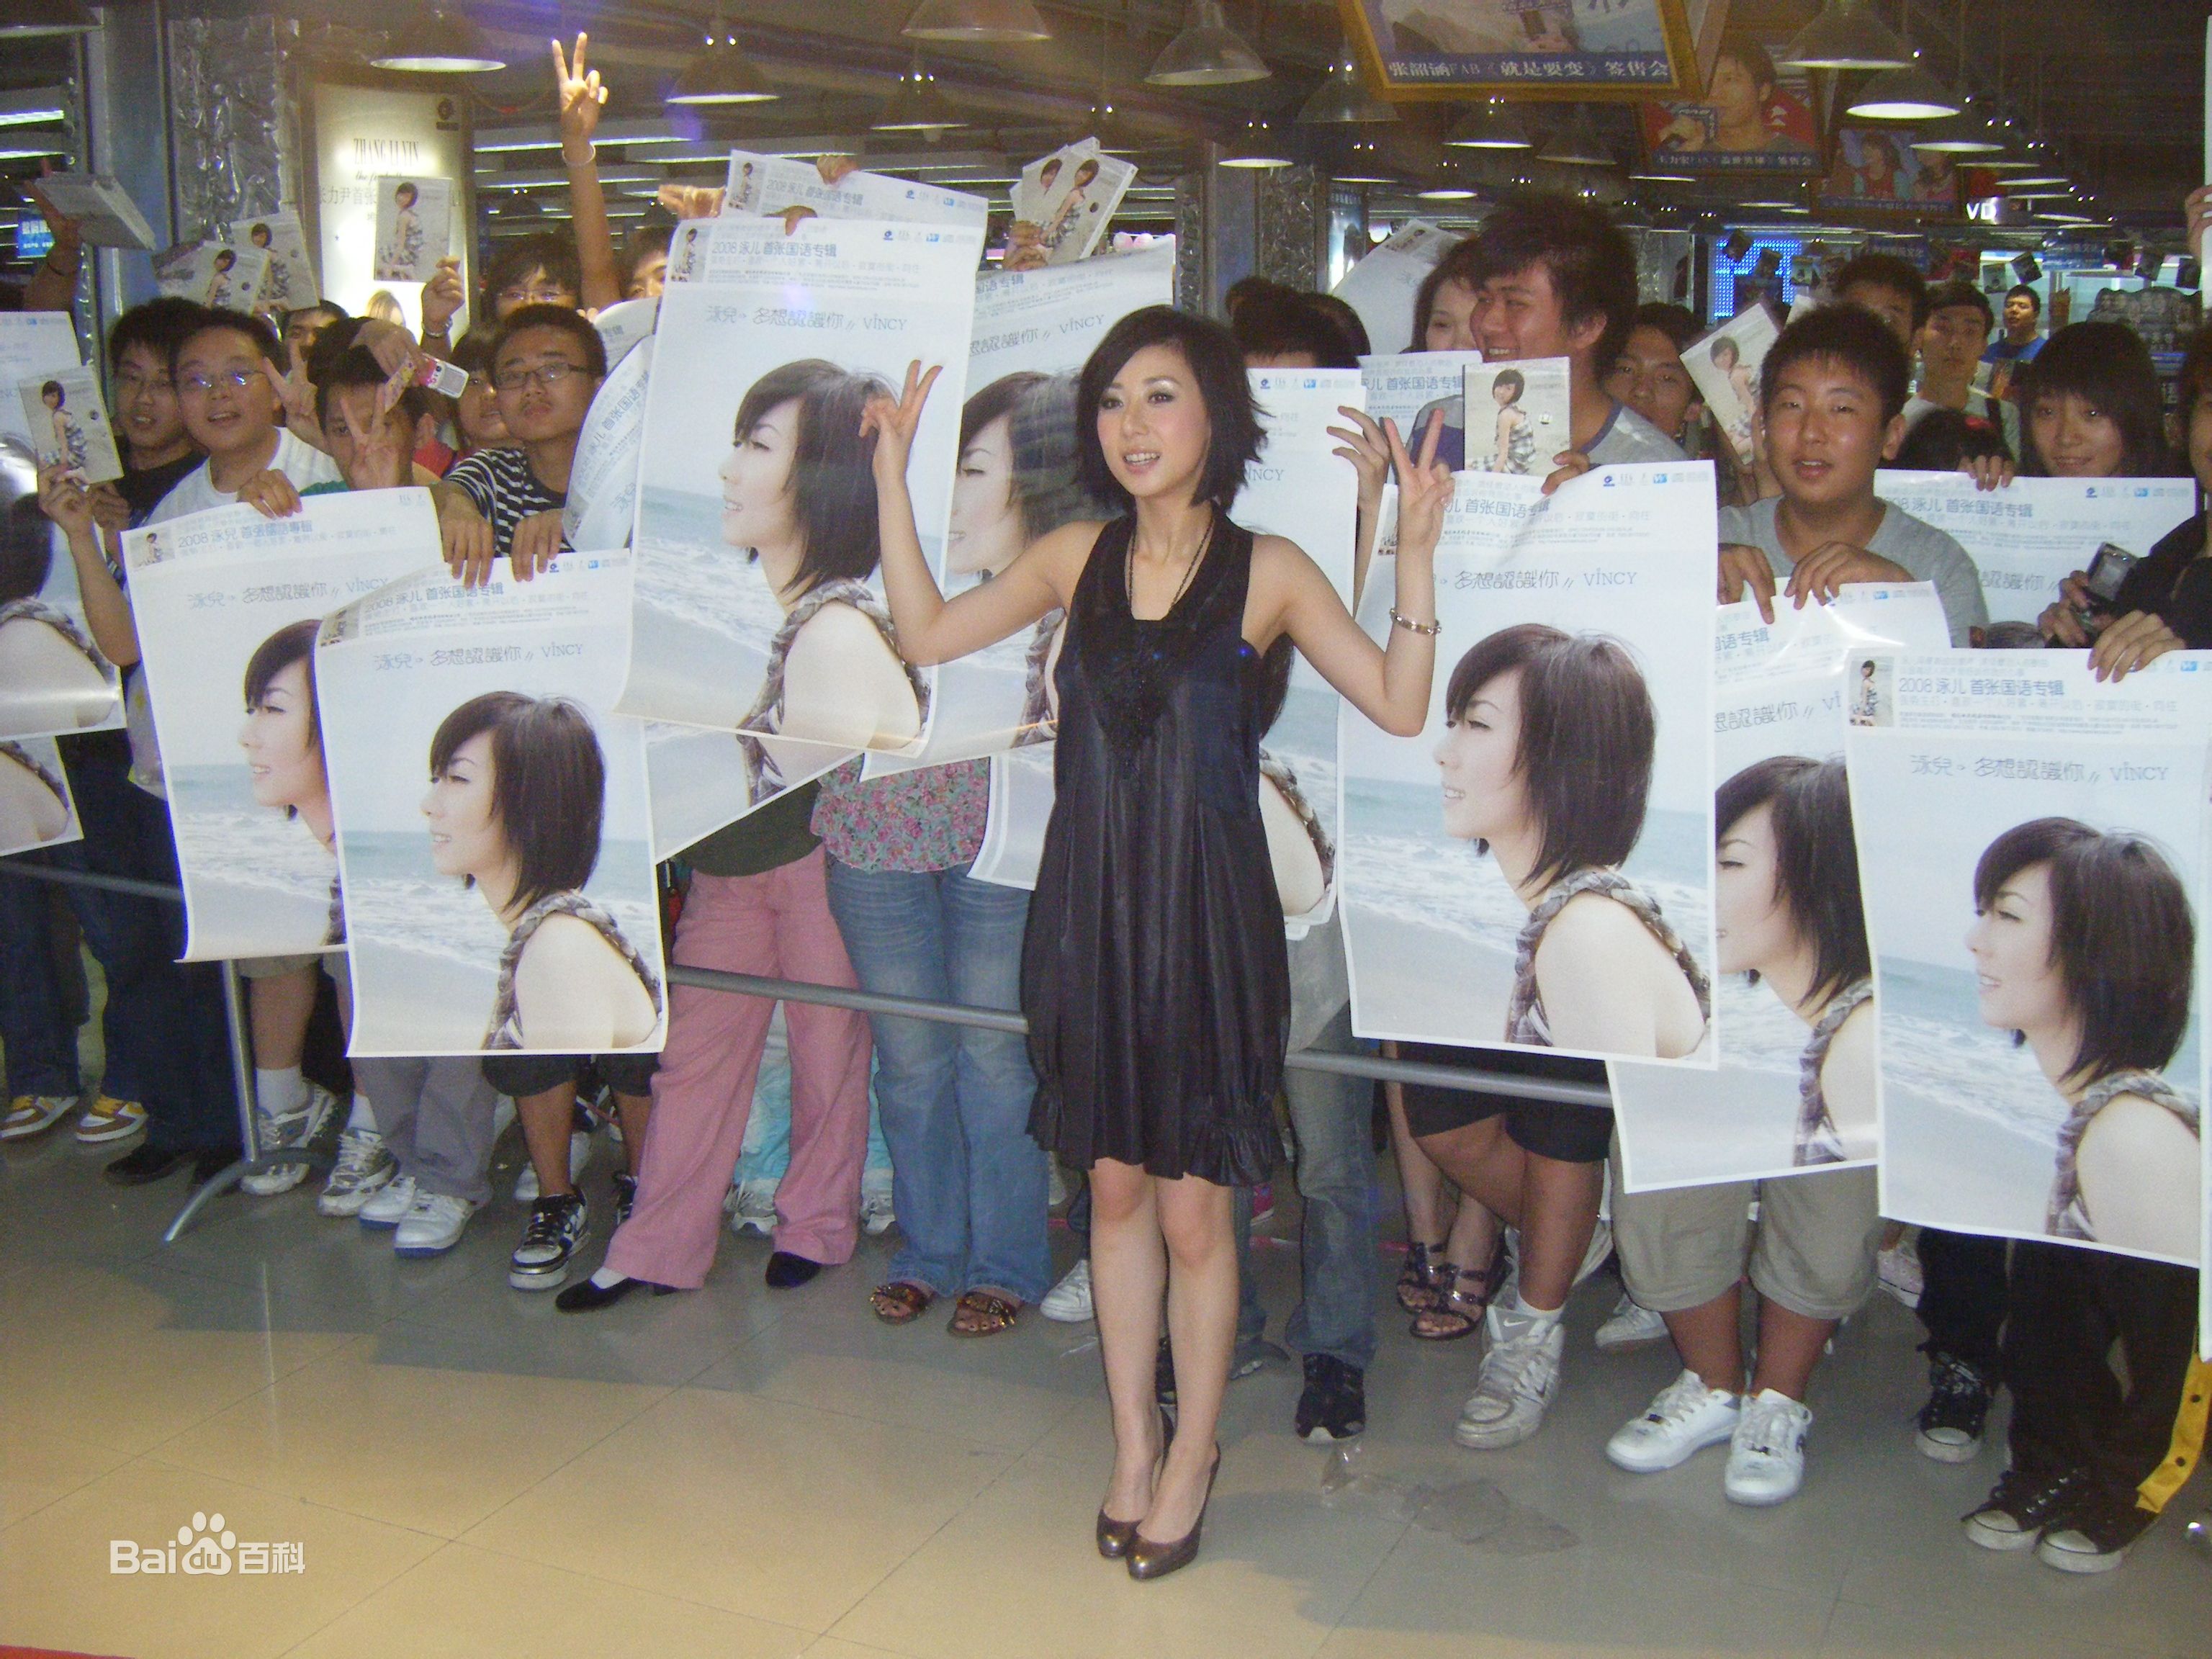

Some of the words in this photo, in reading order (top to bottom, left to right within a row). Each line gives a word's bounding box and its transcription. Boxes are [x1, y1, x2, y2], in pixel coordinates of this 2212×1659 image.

[711, 241, 738, 255] 2008
[739, 241, 760, 256] 泳儿
[762, 242, 837, 258] 首张国语专辑
[1387, 376, 1462, 391] 首张国语专辑
[1946, 498, 2033, 518] 首张国语专辑
[178, 535, 209, 549] 2008
[364, 598, 393, 613] 2008
[426, 582, 504, 602] 首张国语专辑
[1899, 678, 1933, 693] 2008
[1936, 678, 1966, 695] 泳儿
[1970, 679, 2064, 696] 首张国语专辑
